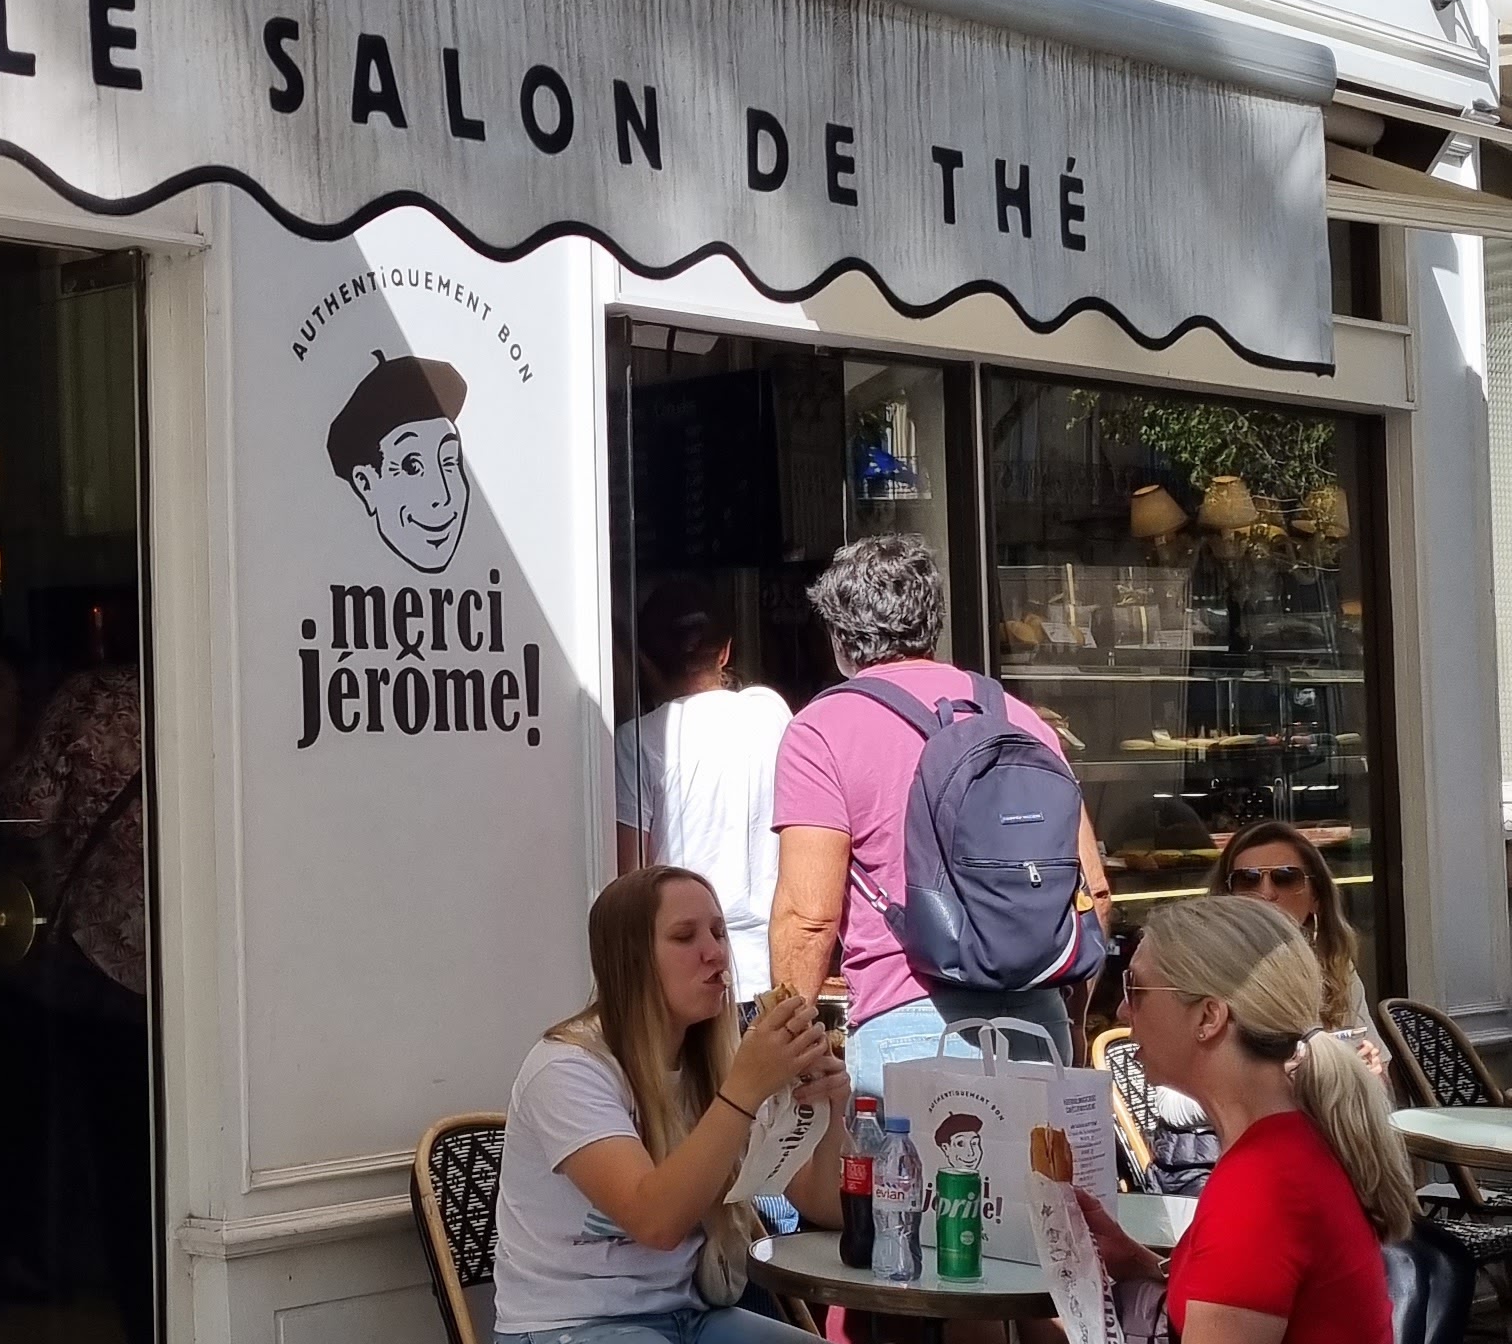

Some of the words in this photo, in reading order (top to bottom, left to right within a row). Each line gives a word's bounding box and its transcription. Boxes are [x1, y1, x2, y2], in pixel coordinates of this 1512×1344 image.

[264, 15, 663, 173] SALON
[746, 106, 860, 207] DE
[931, 144, 1087, 254] THÉ
[497, 323, 534, 384] BON
[329, 568, 505, 653] merci
[296, 618, 541, 750] jérôme!
[875, 1186, 906, 1201] evian
